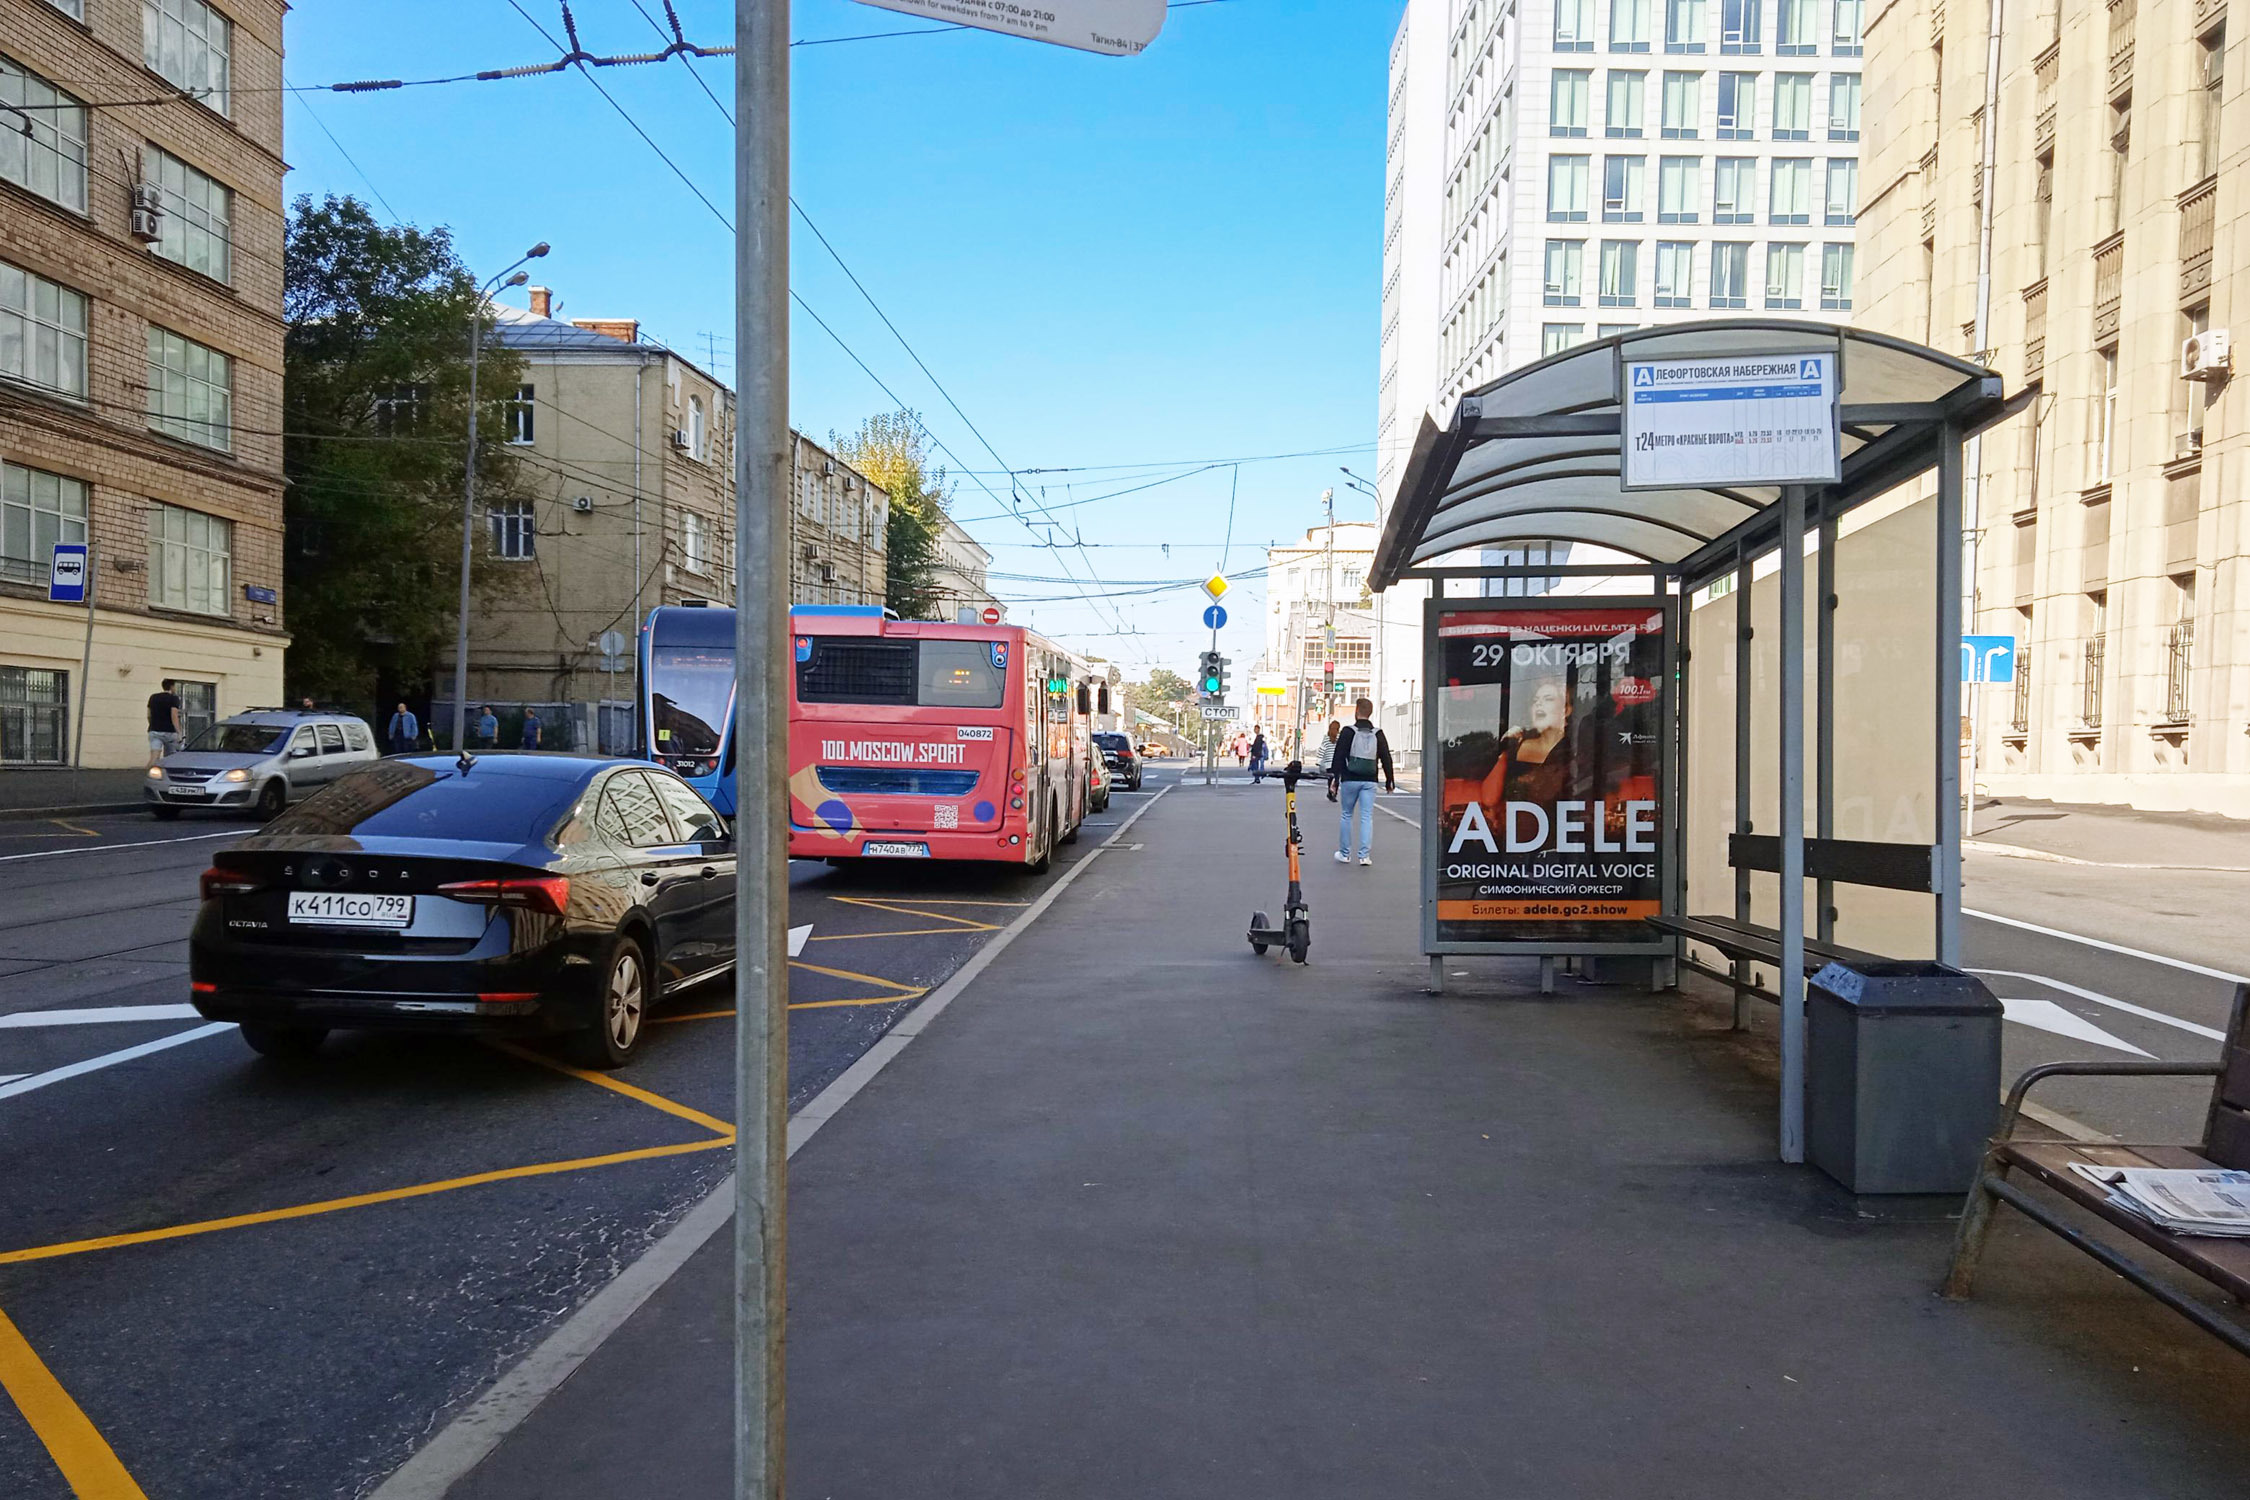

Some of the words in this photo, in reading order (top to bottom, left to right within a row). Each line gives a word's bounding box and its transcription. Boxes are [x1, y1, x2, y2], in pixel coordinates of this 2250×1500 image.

[940, 3, 978, 18] weekdays
[980, 10, 999, 21] from
[1006, 17, 1018, 26] am
[1020, 19, 1028, 27] to
[1036, 23, 1048, 32] pm
[995, 3, 1019, 15] 07:00
[1021, 9, 1031, 18] до
[1033, 9, 1056, 22] 21:00
[1091, 32, 1128, 49] Тагил-84
[1656, 366, 1731, 381] ЛЕФОРТОВСКАЯ
[1732, 363, 1796, 377] НАБЕРЕЖНАЯ
[1655, 434, 1675, 447] МЕТРО
[1523, 625, 1581, 634] НАЦЕНКИ
[1472, 644, 1504, 667] 29
[1511, 642, 1630, 667] ОКТЯБРЯ
[1619, 685, 1645, 695] 100.1
[1205, 707, 1235, 718] СТОП
[958, 729, 992, 739] 040872
[822, 740, 966, 764] 100.MOSCOW.SPORT
[1448, 800, 1656, 853] ADELE
[1447, 864, 1529, 878] ORIGINAL
[1533, 864, 1597, 878] DIGITAL
[1601, 864, 1655, 878] VOICE
[1479, 883, 1576, 894] СИМФОНИЧЕСКИЙ
[1579, 885, 1623, 894] ОРКЕСТР
[376, 896, 405, 912] 799
[1472, 904, 1520, 914] Билеты:
[1523, 904, 1628, 917] adele.go2.show
[229, 920, 268, 928] OCTAVIA
